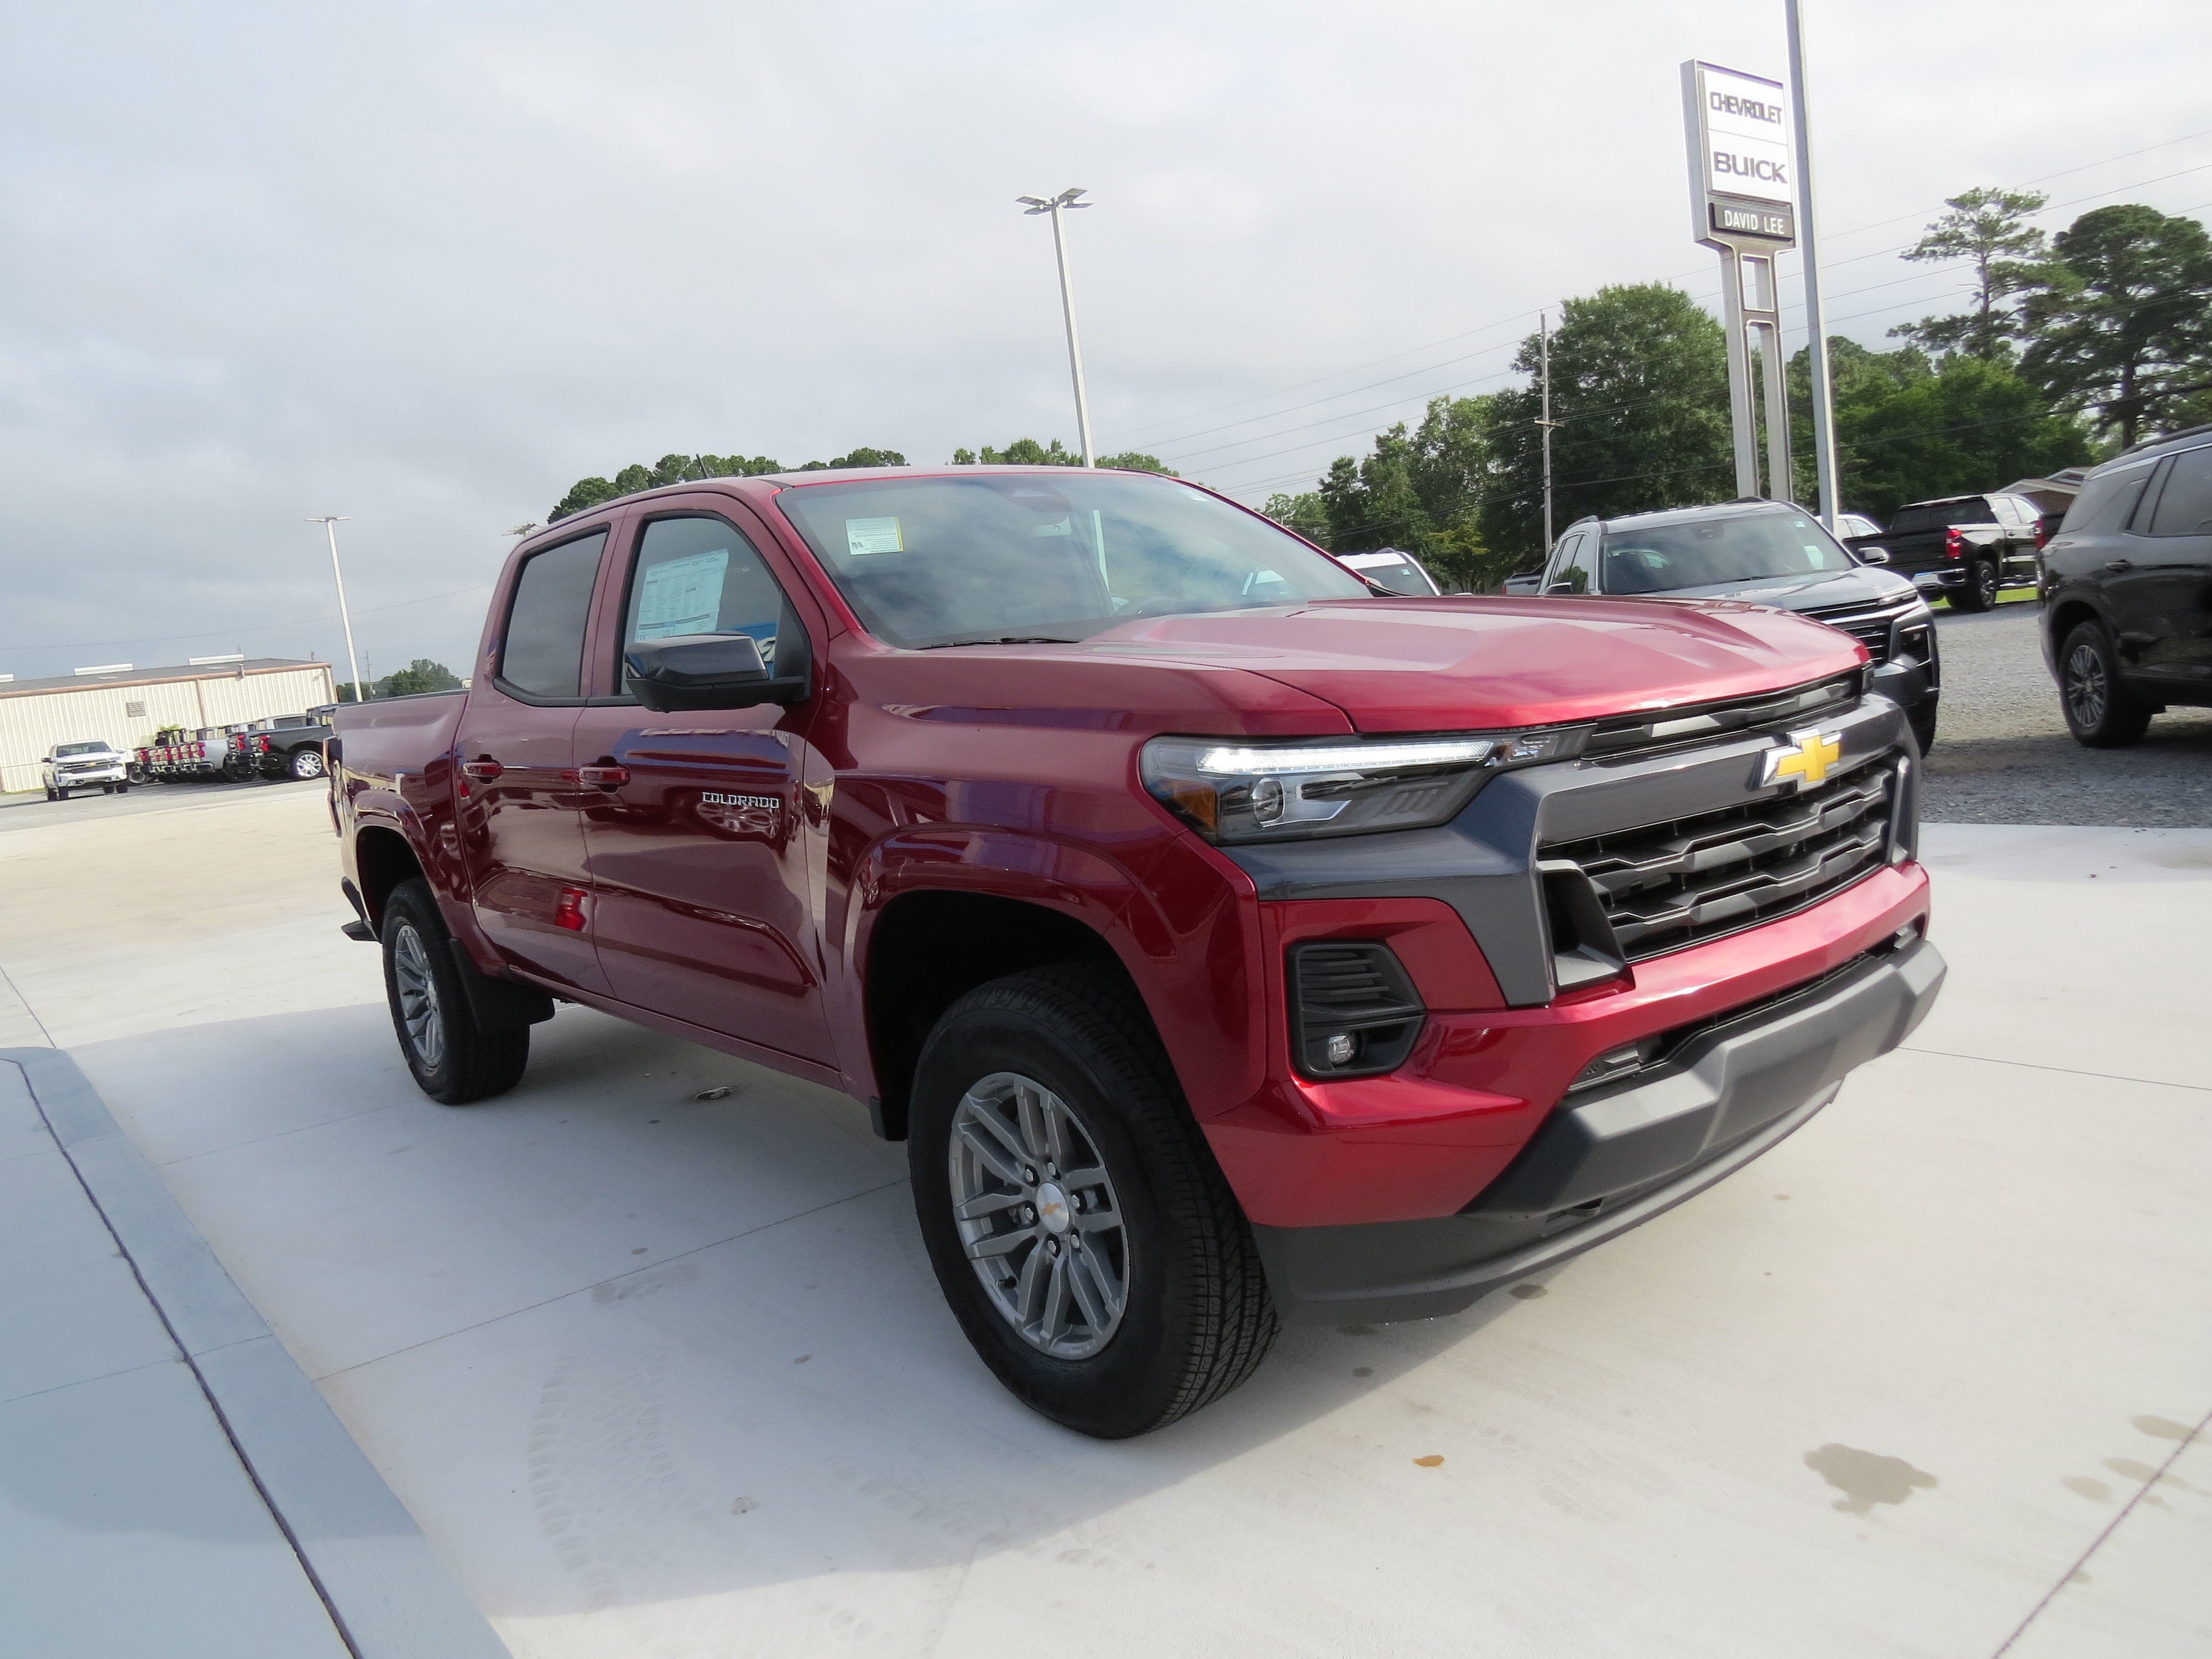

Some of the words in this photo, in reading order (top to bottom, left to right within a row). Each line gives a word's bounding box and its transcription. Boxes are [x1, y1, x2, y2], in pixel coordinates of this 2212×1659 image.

[1710, 92, 1782, 124] CHEVROLET
[1714, 152, 1788, 184] BUICK
[1724, 210, 1758, 231] DAVID
[1764, 217, 1785, 234] LEE
[702, 792, 780, 809] COLORADO
